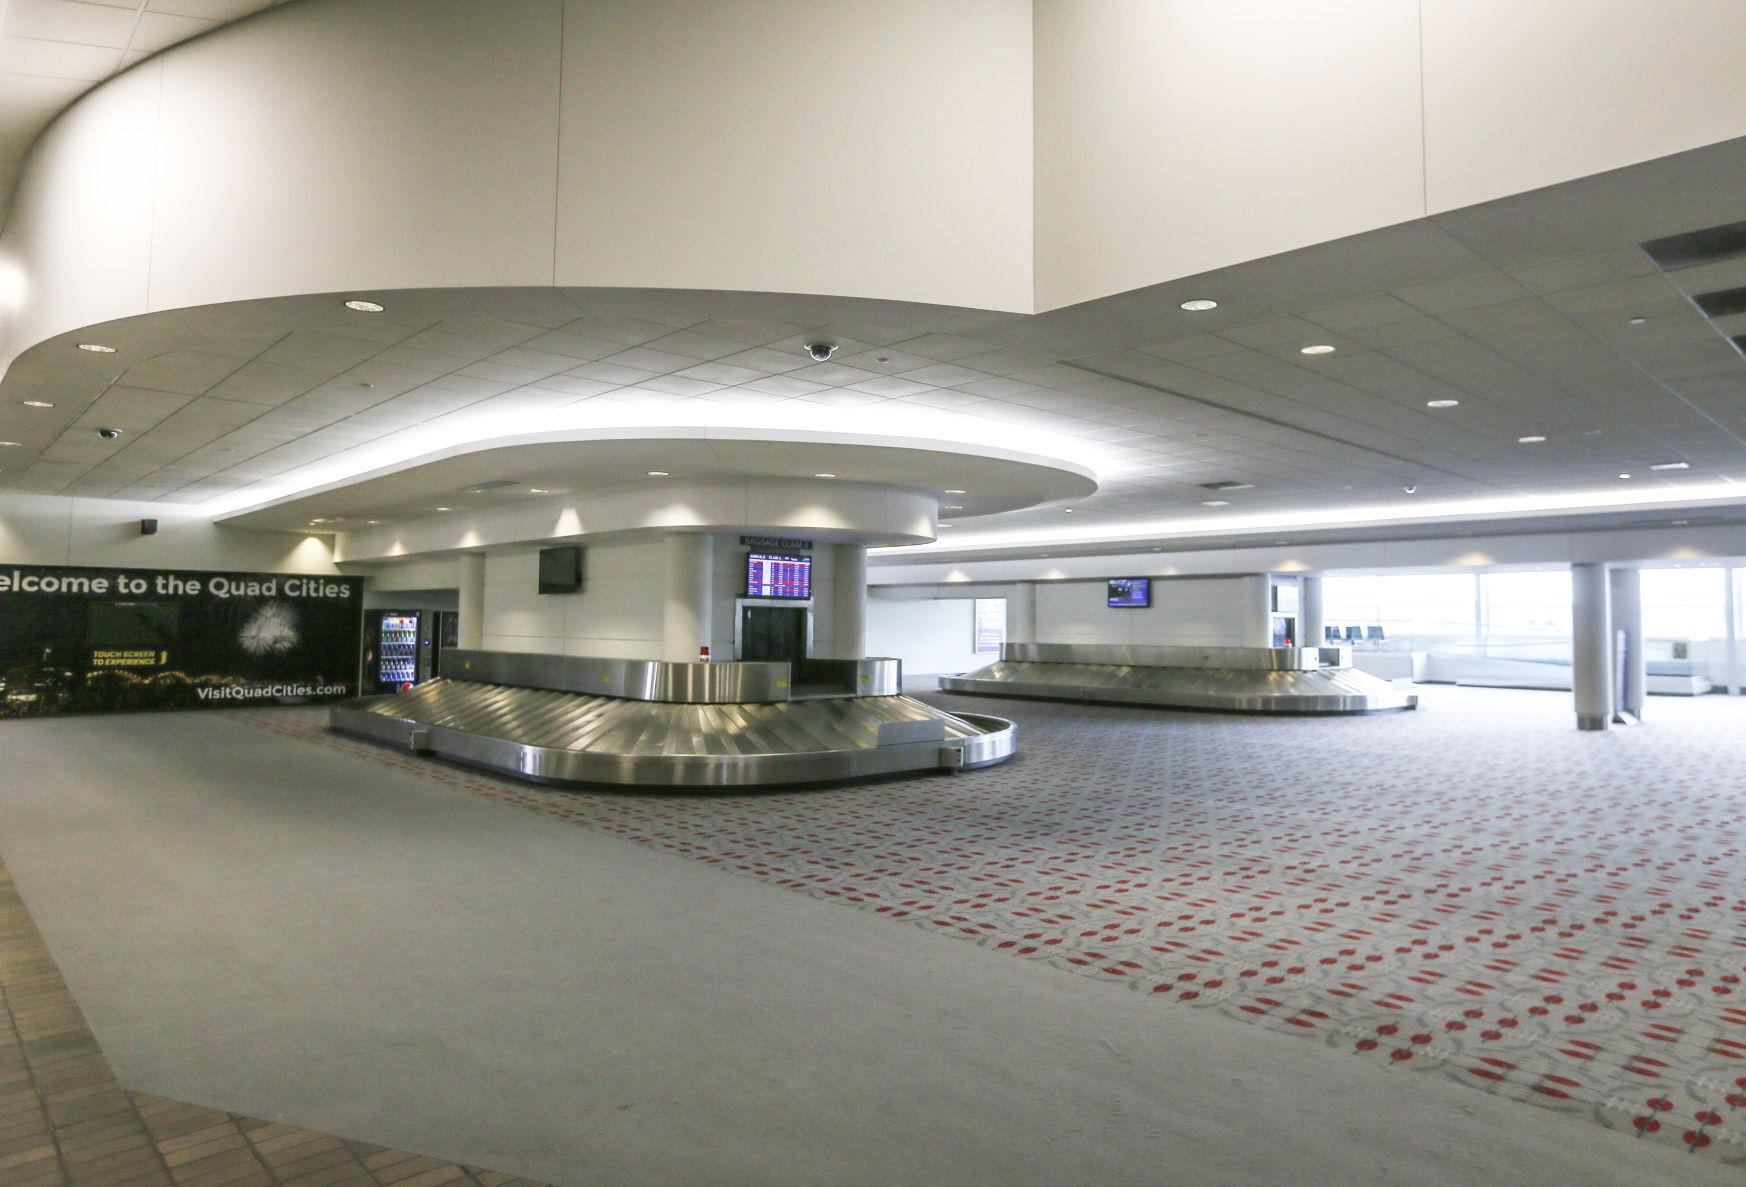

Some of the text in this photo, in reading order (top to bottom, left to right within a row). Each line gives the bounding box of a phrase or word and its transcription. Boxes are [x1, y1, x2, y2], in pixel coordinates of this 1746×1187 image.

[744, 536, 779, 547] BAGGAGE
[781, 539, 801, 549] CLAIM
[117, 574, 148, 594] to
[155, 575, 201, 595] the
[208, 577, 277, 598] Quad
[284, 579, 350, 598] Cities
[197, 684, 346, 700] VisitQuadCities.com
